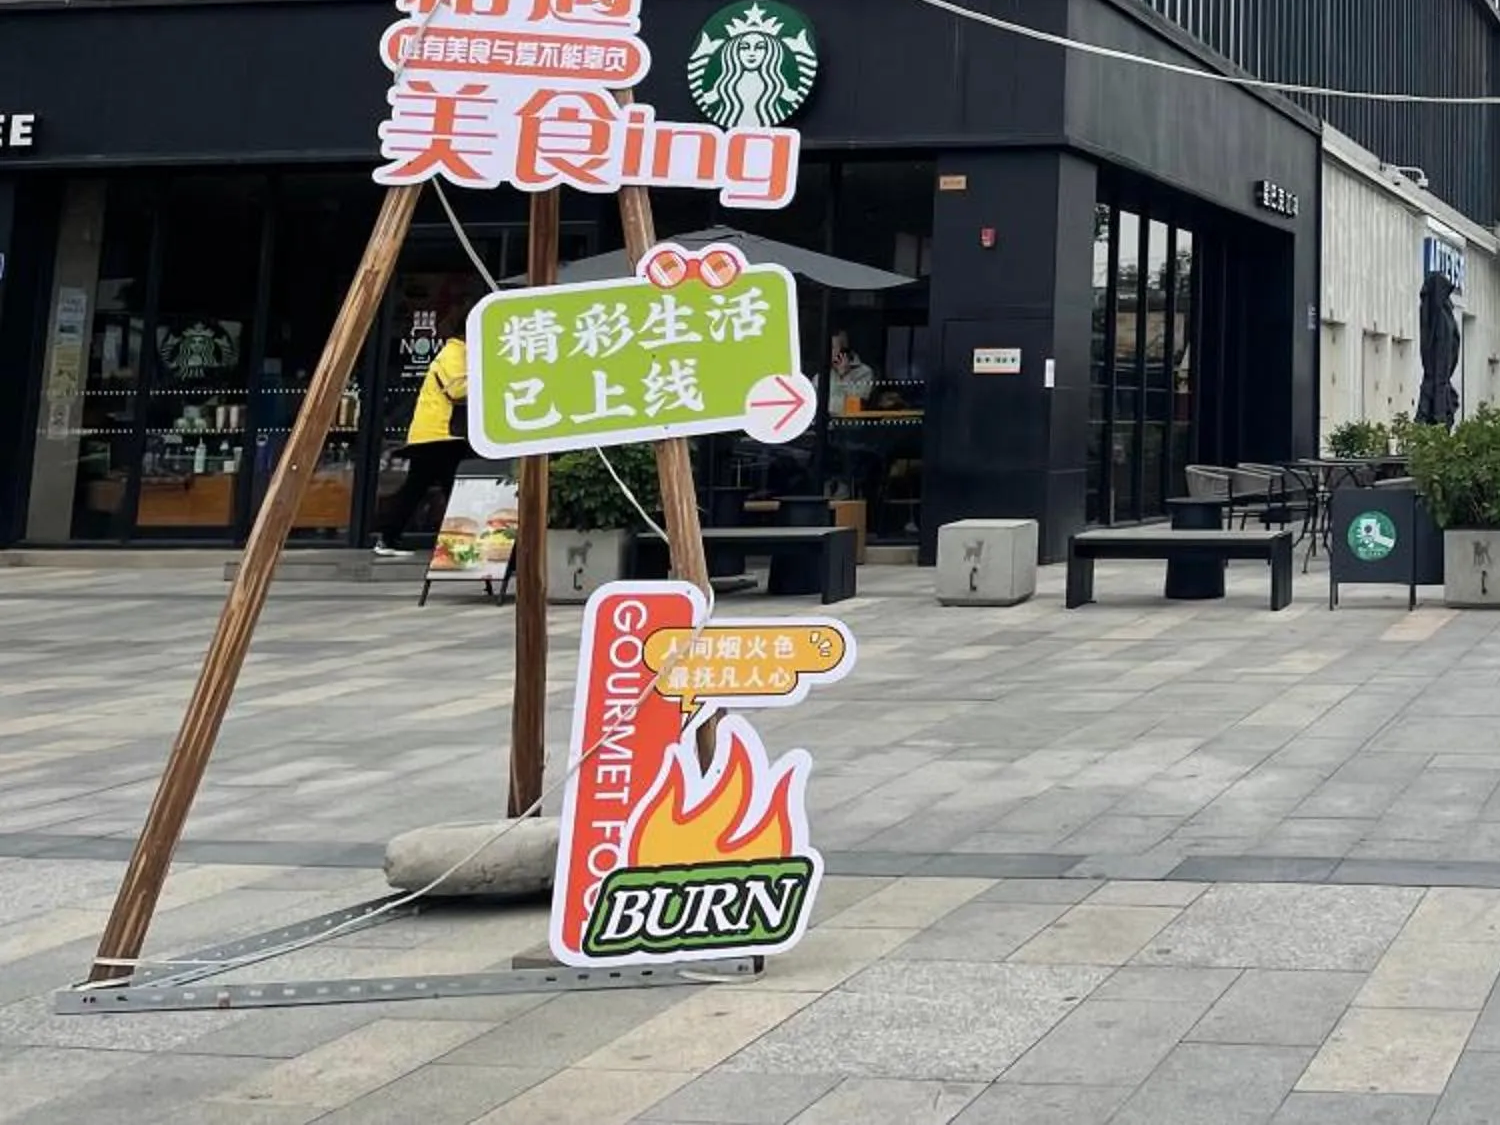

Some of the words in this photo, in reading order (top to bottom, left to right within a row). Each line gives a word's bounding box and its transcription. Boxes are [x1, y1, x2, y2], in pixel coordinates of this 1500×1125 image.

[497, 287, 770, 365] 精彩生活
[504, 358, 705, 431] 已上线
[660, 634, 796, 660] 人间烟火色
[667, 666, 791, 689] 最抚凡人心
[595, 600, 648, 804] GOURMET
[600, 877, 800, 943] BURN
